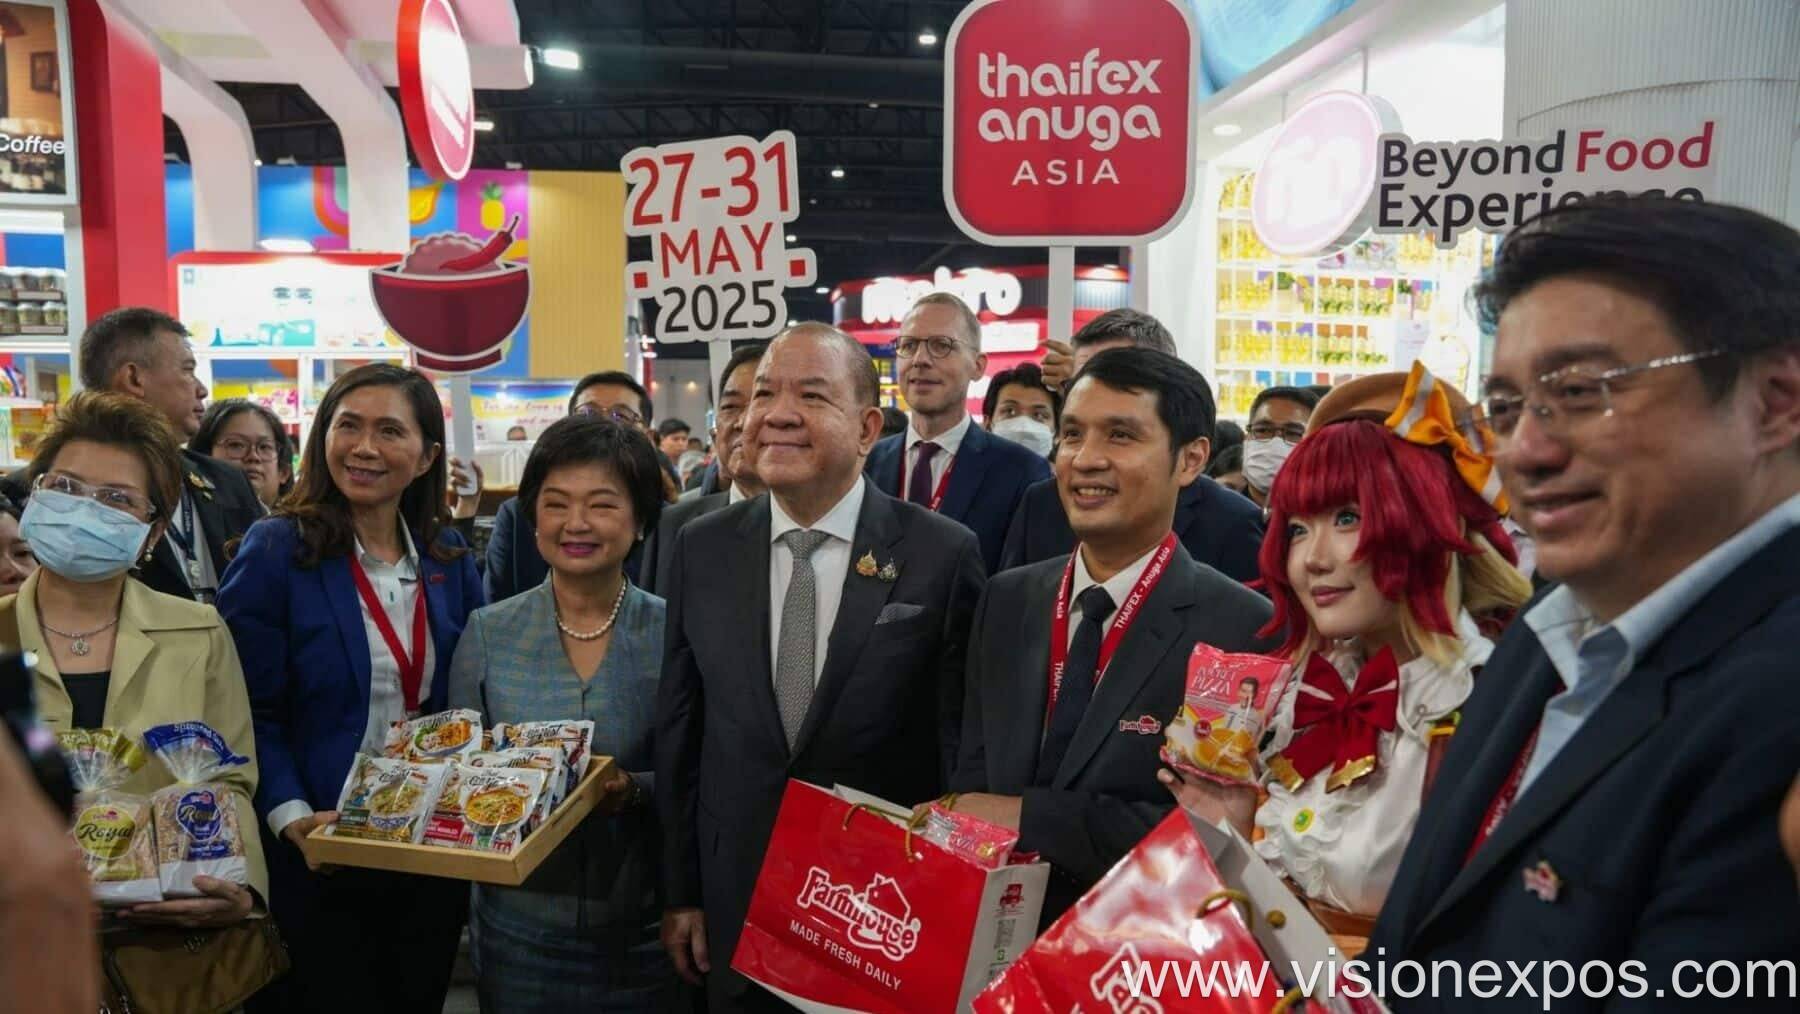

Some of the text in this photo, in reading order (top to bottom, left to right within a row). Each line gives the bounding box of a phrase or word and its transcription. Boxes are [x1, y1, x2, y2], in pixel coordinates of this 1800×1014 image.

[979, 47, 1161, 98] thaifex
[0, 133, 65, 154] Coffee
[978, 105, 1161, 151] anuga
[1382, 121, 1714, 190] Beyond Food
[629, 142, 789, 227] 27-31
[1012, 159, 1119, 185] ASIA
[1378, 178, 1705, 242] Experi
[660, 222, 774, 278] MAY
[664, 279, 776, 333] 2025
[1114, 591, 1142, 629] THAIFEX
[1141, 562, 1161, 588] Anuga
[798, 867, 918, 960] Farmhouse
[790, 919, 902, 991] MADE FRESH DAILY
